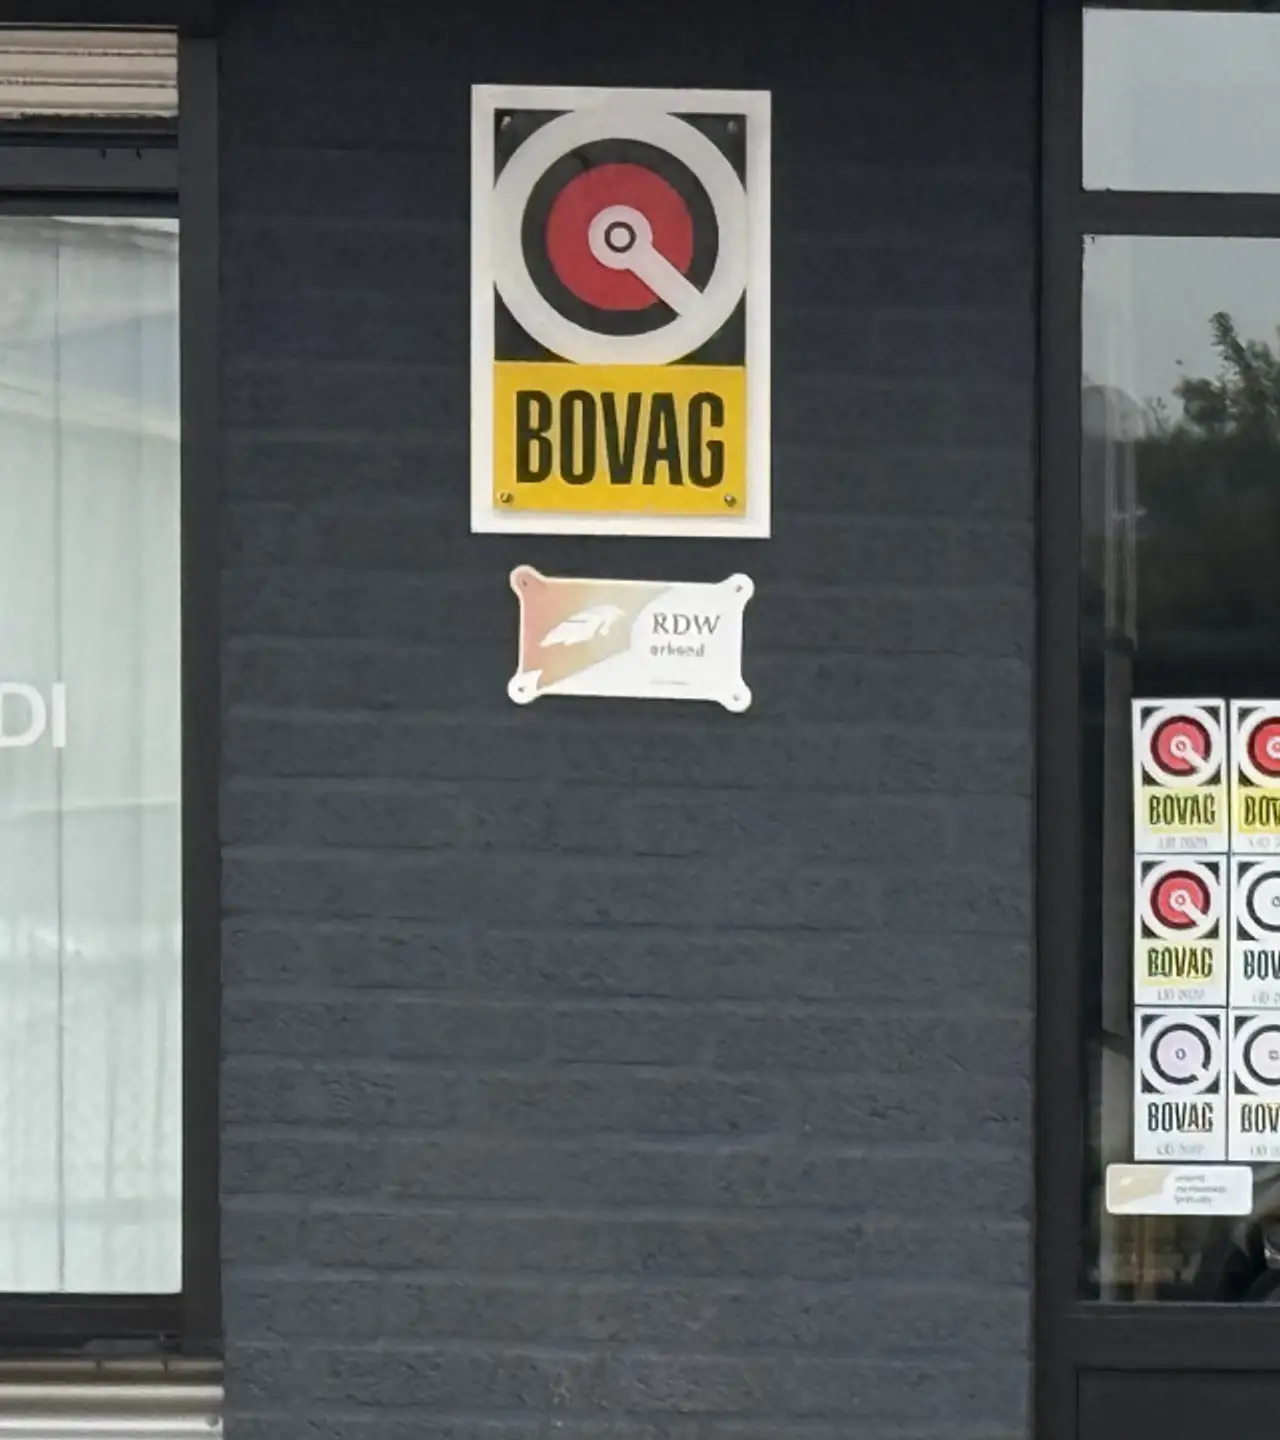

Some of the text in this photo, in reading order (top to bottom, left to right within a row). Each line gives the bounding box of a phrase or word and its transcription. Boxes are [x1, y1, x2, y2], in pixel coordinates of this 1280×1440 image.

[515, 389, 724, 488] BOVAG
[652, 612, 721, 635] RDW
[1149, 794, 1216, 826] BOVAG
[1147, 946, 1214, 978] BOVAG
[1147, 1101, 1214, 1133] BOVAG
